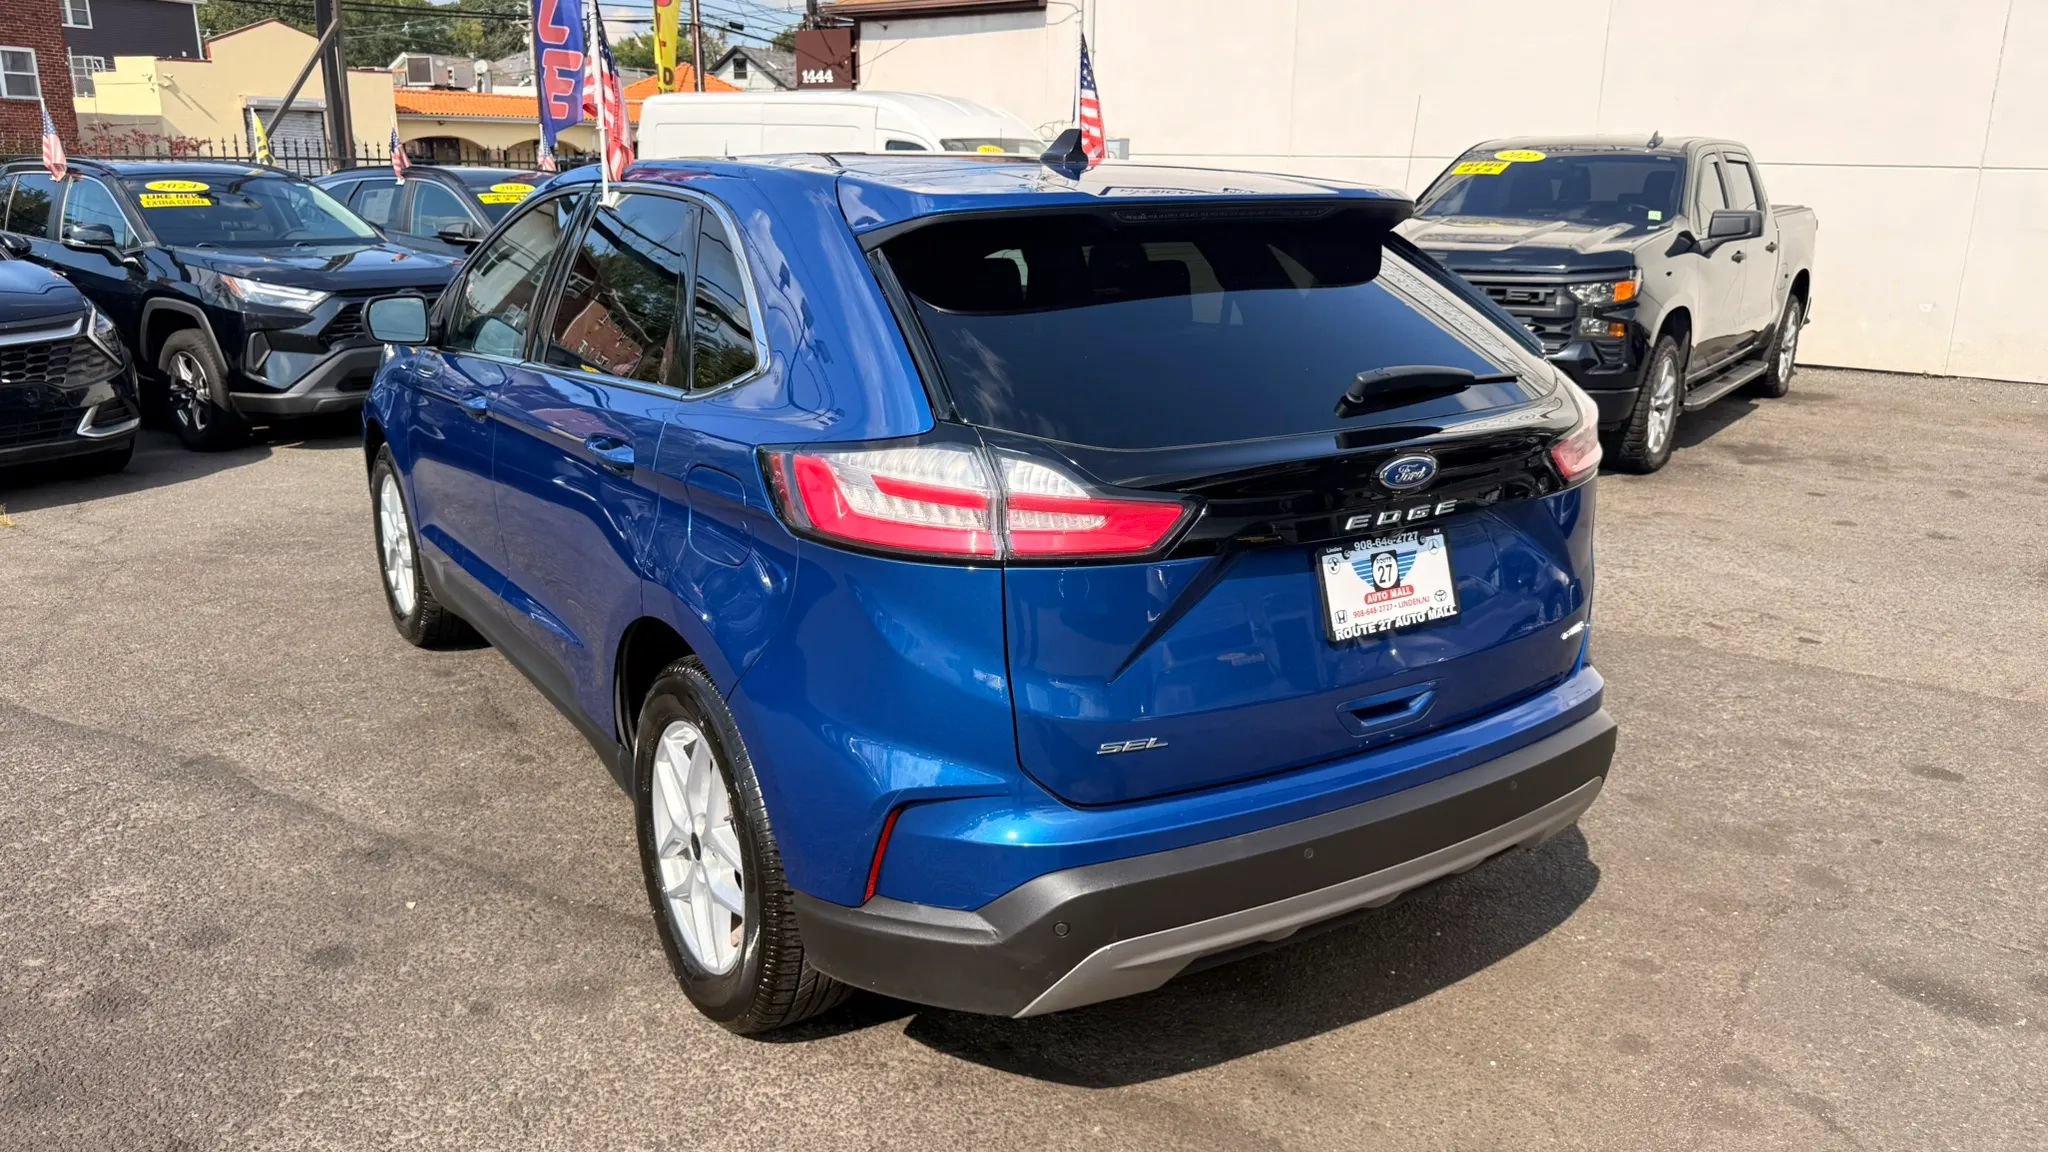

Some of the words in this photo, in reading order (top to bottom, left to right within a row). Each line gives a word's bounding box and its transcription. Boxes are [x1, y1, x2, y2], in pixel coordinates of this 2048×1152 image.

[801, 69, 834, 84] 1444
[157, 182, 198, 190] 2024
[1395, 463, 1426, 482] Ford
[1344, 499, 1458, 531] EDGE
[1375, 556, 1393, 565] ROUTE
[1377, 563, 1393, 584] 27
[1366, 592, 1387, 605] AUTO
[1390, 586, 1411, 599] MALL
[1335, 623, 1377, 641] ROUTE
[1378, 618, 1393, 632] 27
[1394, 611, 1426, 629] AUTO
[1427, 605, 1457, 619] MALL
[1096, 737, 1169, 756] SEL
